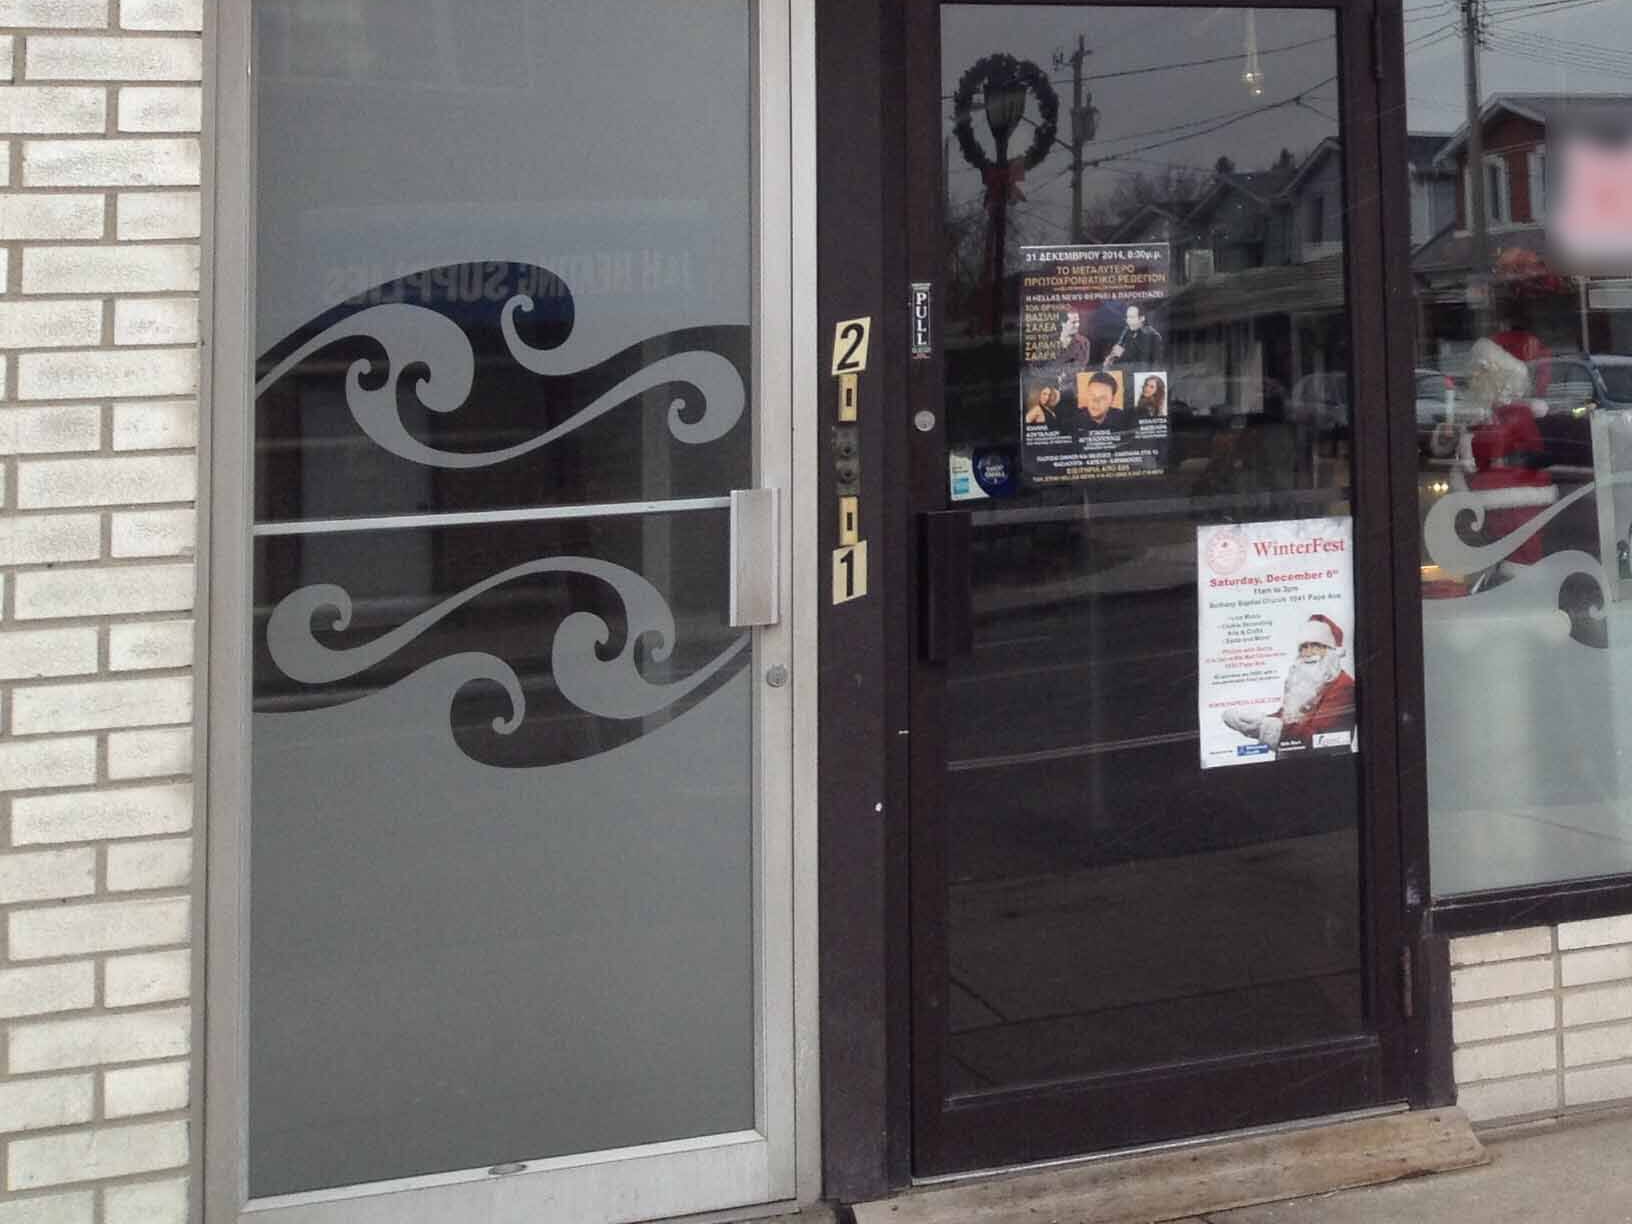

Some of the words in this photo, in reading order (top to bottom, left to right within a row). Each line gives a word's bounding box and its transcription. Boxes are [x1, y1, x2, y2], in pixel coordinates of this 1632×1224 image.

[915, 292, 927, 345] PULL
[837, 322, 864, 371] 2
[1252, 537, 1345, 558] WinterFest
[840, 549, 855, 597] 1
[1209, 576, 1263, 588] Saturday,
[1266, 570, 1323, 583] December
